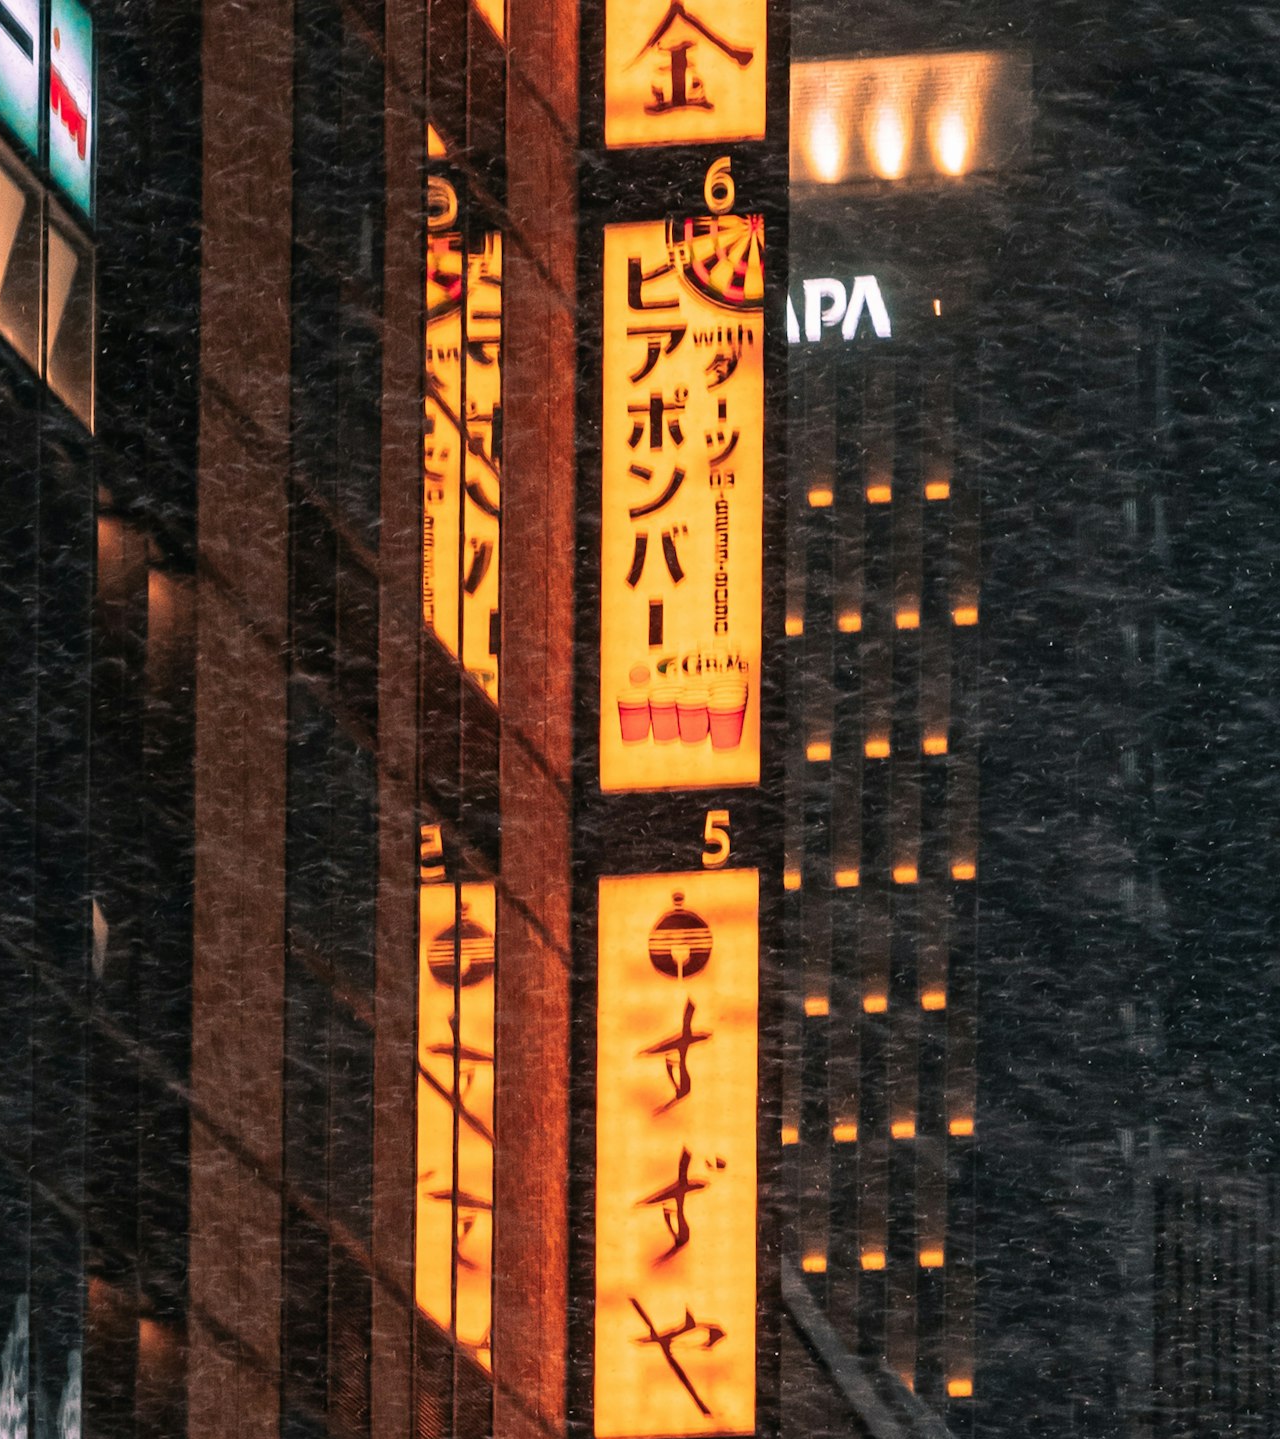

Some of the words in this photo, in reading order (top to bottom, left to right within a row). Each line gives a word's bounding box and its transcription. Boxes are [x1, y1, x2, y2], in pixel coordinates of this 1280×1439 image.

[703, 156, 736, 214] 6
[693, 325, 754, 347] with
[786, 275, 892, 343] PA
[625, 247, 689, 647] ビアポンバー
[702, 810, 731, 870] 5
